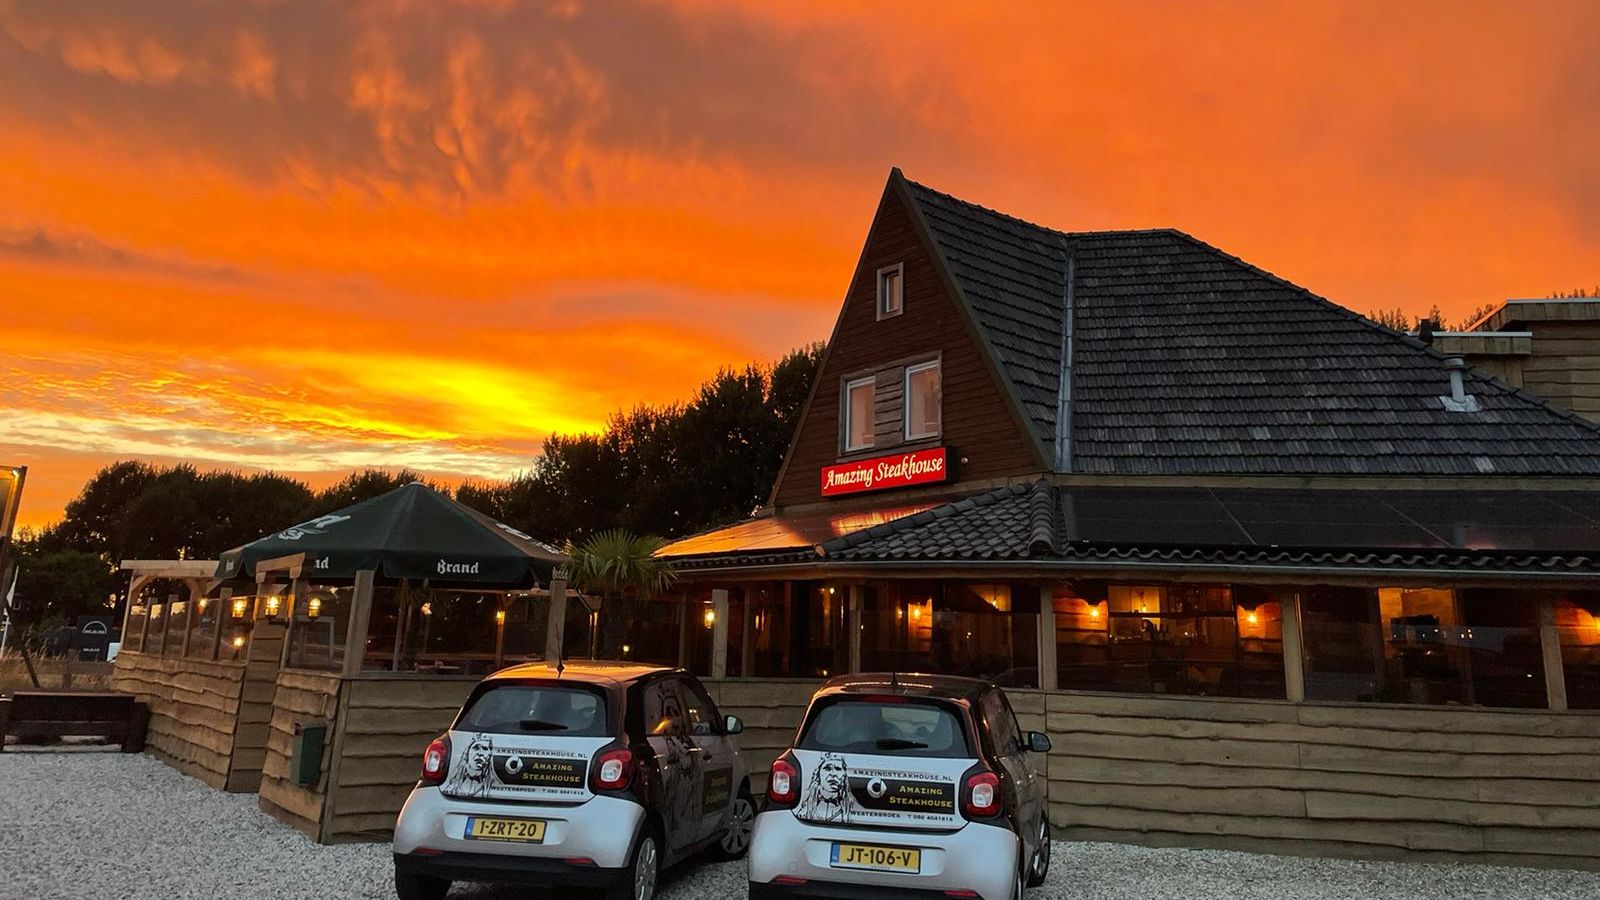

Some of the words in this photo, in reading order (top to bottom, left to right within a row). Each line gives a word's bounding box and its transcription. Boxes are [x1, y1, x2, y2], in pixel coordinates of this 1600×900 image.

[824, 465, 873, 488] Amazing
[875, 455, 943, 480] Steakhouse
[436, 559, 479, 575] Brand
[533, 762, 573, 771] AMAZING
[522, 773, 581, 783] STEAKHOUSE
[853, 771, 953, 781] AMAZINGSTEAKHOUSE.NL
[899, 785, 943, 796] AMAZING
[889, 797, 953, 808] STEAKHOUSE
[479, 820, 537, 837] 1-ZRT-20
[846, 847, 911, 866] JT-106-V
